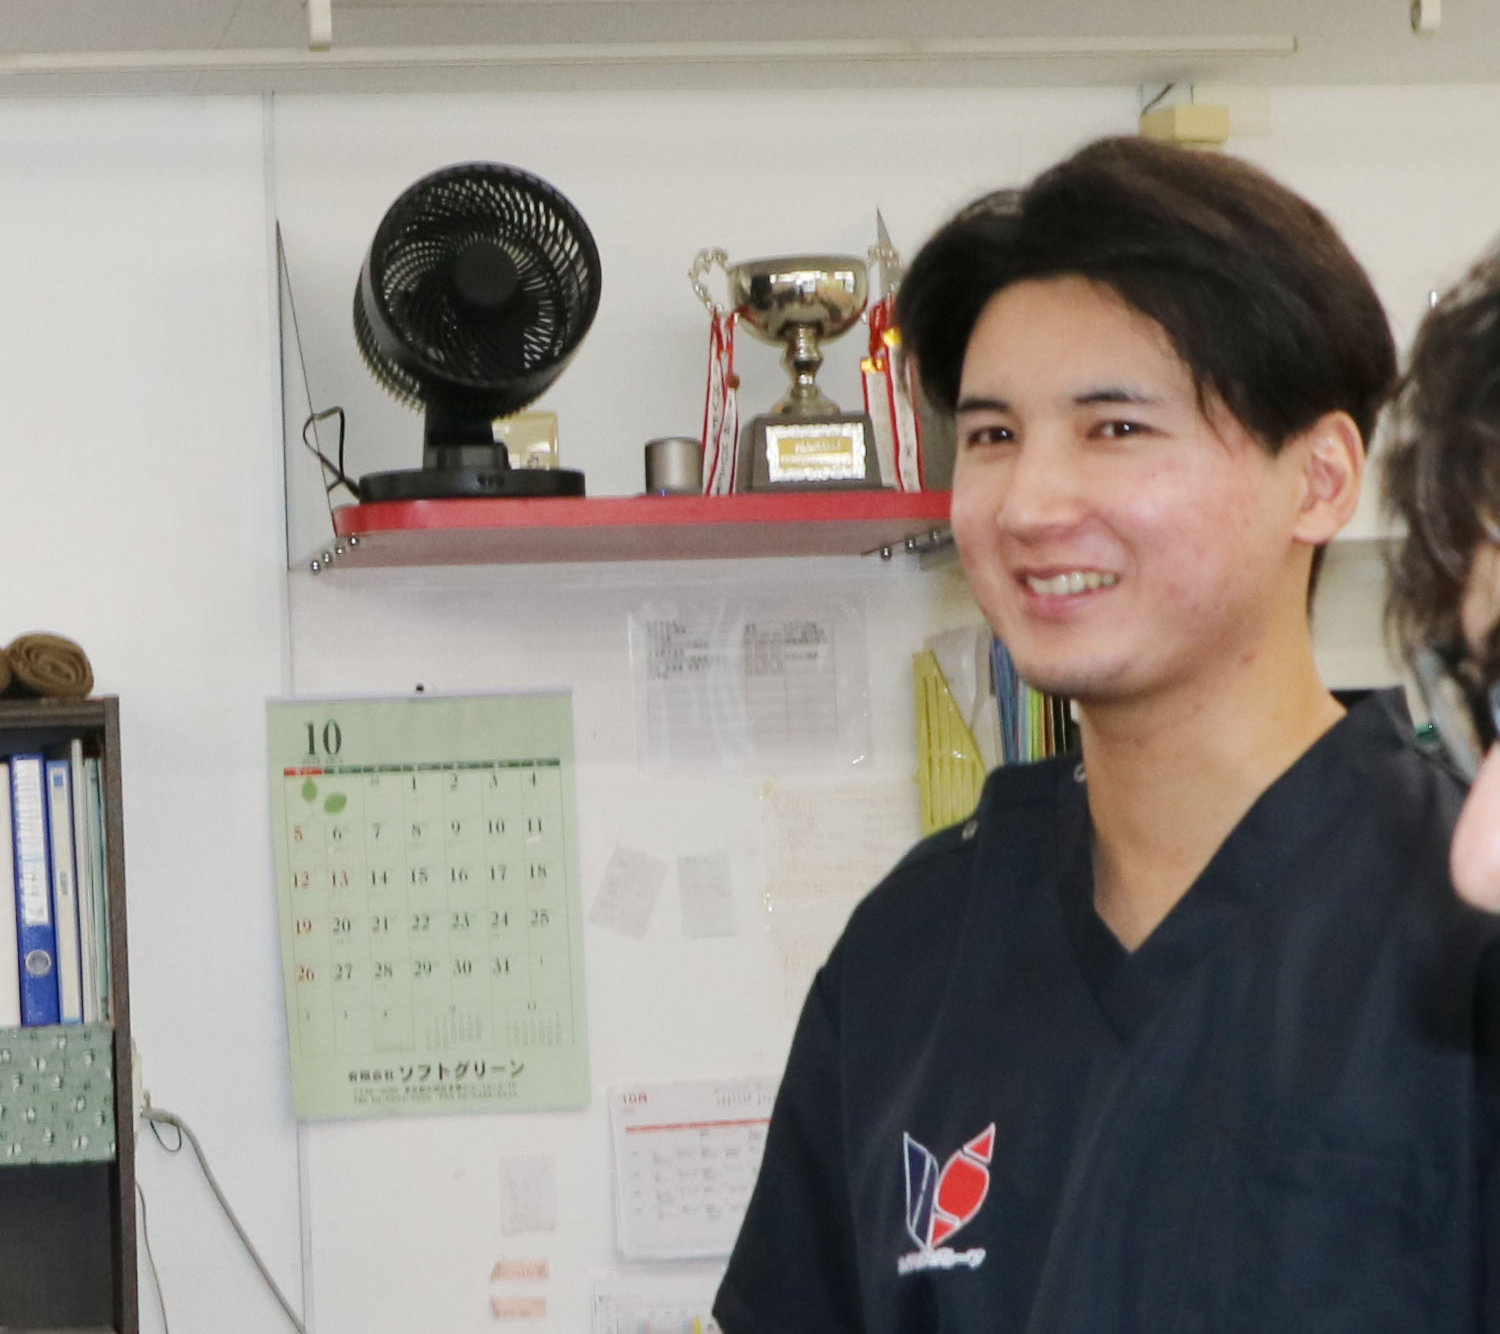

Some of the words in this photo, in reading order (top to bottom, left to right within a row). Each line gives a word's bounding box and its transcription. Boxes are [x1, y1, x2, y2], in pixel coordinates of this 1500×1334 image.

[304, 719, 342, 756] 10
[488, 819, 505, 835] 10
[527, 817, 543, 834] 11
[293, 872, 310, 889] 12
[332, 870, 349, 887] 13
[371, 869, 388, 886] 14
[411, 868, 429, 884] 15
[451, 867, 468, 883] 16
[490, 865, 507, 882] 17
[529, 863, 548, 879] 18
[296, 919, 312, 935] 19
[333, 917, 352, 933] 20
[372, 916, 389, 933] 21
[412, 914, 430, 932] 22
[452, 913, 470, 929] 23
[490, 911, 509, 927] 24
[530, 909, 550, 926] 25
[298, 964, 315, 982] 26
[335, 963, 352, 980] 27
[375, 962, 393, 979] 28
[414, 960, 432, 977] 29
[453, 959, 472, 975] 30
[492, 957, 510, 974] 31
[400, 1059, 525, 1082] ソフトグリーン
[622, 1092, 648, 1106] 10月
